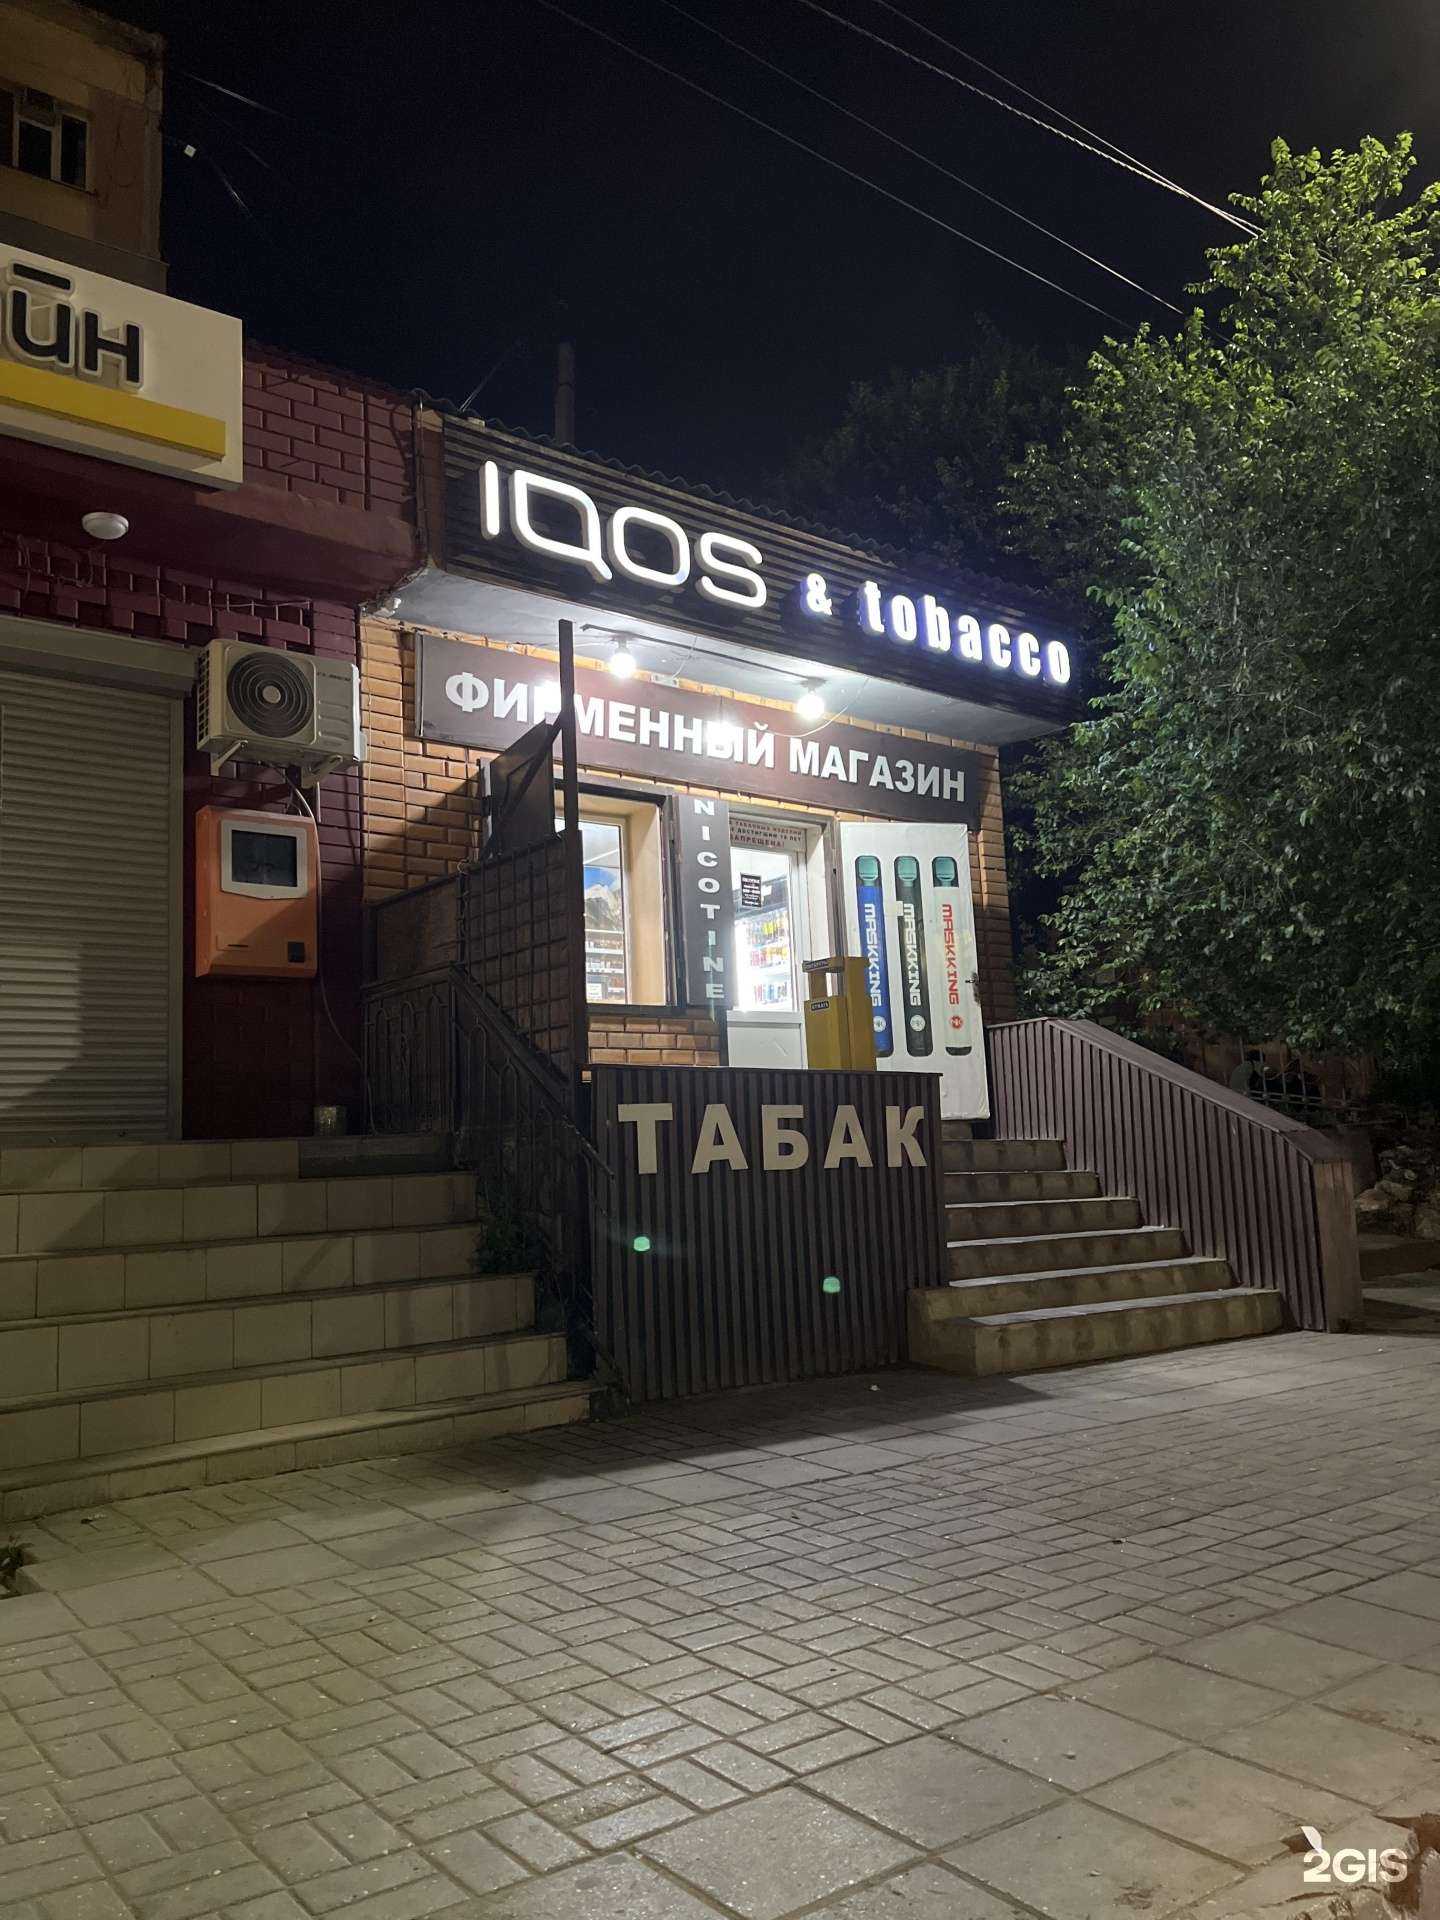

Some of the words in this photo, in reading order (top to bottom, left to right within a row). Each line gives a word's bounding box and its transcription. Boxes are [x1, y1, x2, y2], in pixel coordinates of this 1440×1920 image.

[479, 460, 767, 608] IQOS
[801, 572, 833, 617] &
[858, 580, 1071, 684] tobacco
[789, 736, 966, 802] МАГАЗИН
[693, 798, 725, 999] NICOTINE
[864, 903, 882, 1007] MASKKING
[902, 903, 921, 1007] MASKKING
[942, 903, 960, 1006] MASKKING
[617, 1102, 928, 1174] ТАБАК
